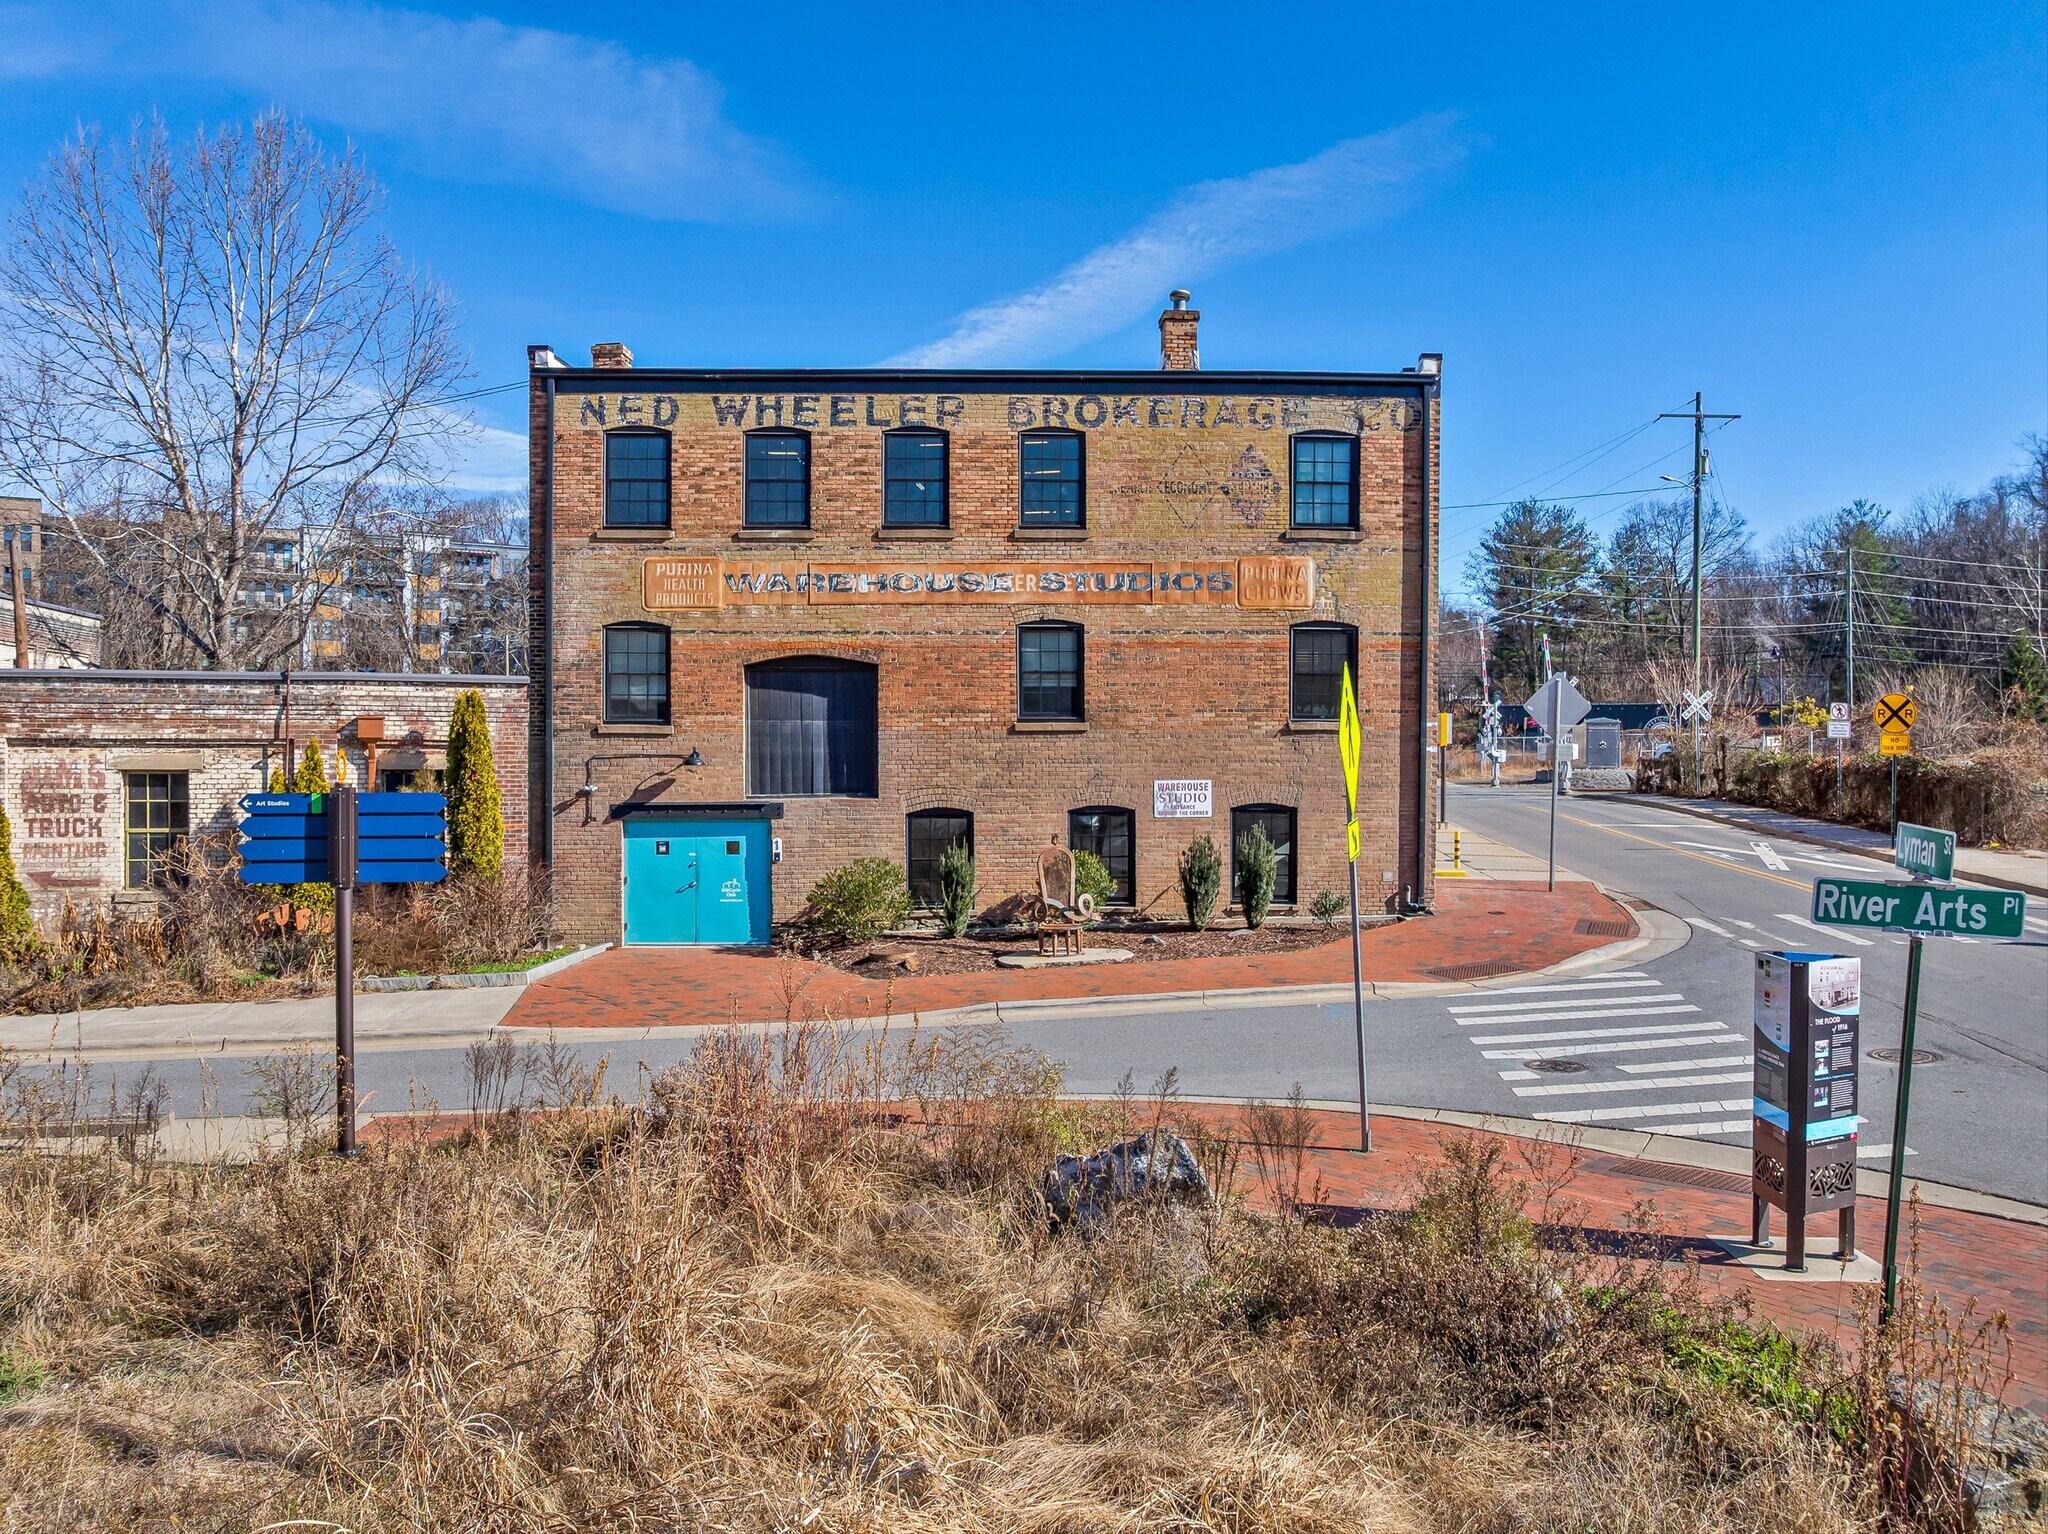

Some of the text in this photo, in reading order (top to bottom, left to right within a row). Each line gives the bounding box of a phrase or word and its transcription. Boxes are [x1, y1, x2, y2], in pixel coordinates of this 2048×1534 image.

[580, 394, 679, 427] NED
[711, 394, 965, 427] WHEELER
[1007, 395, 1311, 430] BROKERAGE
[656, 562, 713, 576] PURINA
[1243, 565, 1308, 581] PURINA
[663, 578, 705, 591] HEALTH
[723, 572, 1015, 593] WAREHOUSE
[1038, 571, 1235, 593] STUDIOS
[655, 592, 714, 606] PRODUCTS
[1244, 585, 1305, 600] CHOWS
[1877, 708, 1914, 719] R R
[1157, 782, 1209, 792] WAREHOUSE
[22, 792, 81, 814] AUTO
[1158, 792, 1207, 804] STUDIO
[23, 817, 103, 838] TRUCK
[23, 841, 107, 859] PAINTING
[1897, 826, 1953, 868] Lyman St
[1817, 883, 2019, 930] River Arts Pl
[1814, 1016, 1841, 1026] THE FLOOD
[1837, 1023, 1849, 1031] 1916
